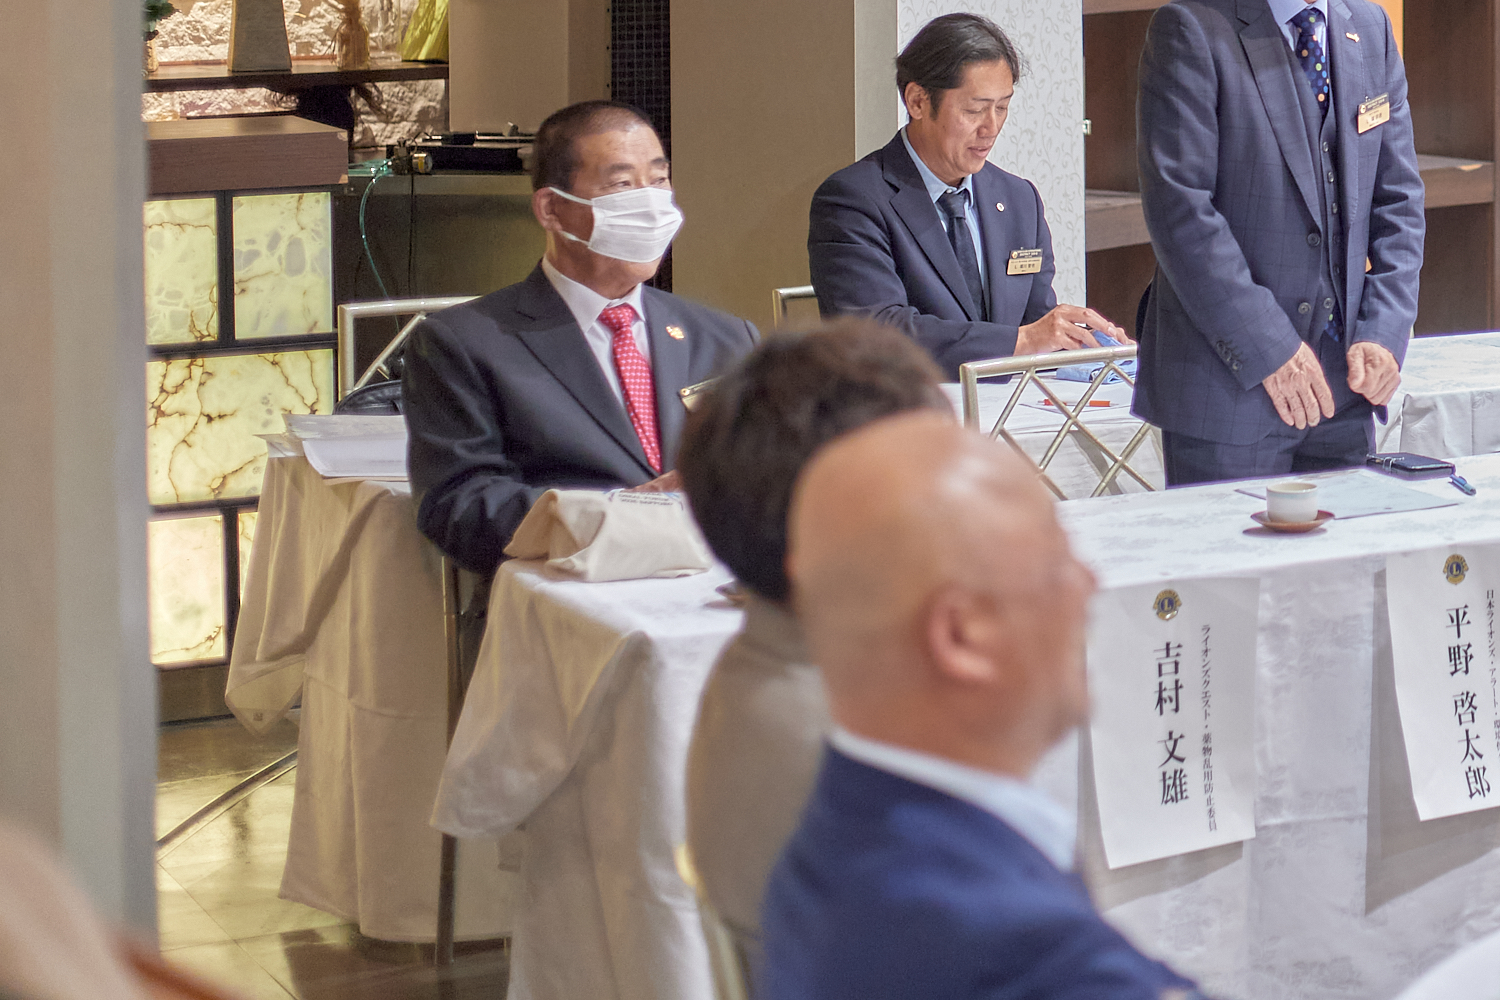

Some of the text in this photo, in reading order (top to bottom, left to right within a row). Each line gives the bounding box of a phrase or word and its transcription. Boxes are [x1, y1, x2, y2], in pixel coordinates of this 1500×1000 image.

[1153, 641, 1190, 805] 吉村 文雄
[1445, 603, 1491, 799] 平野 啓太郎
